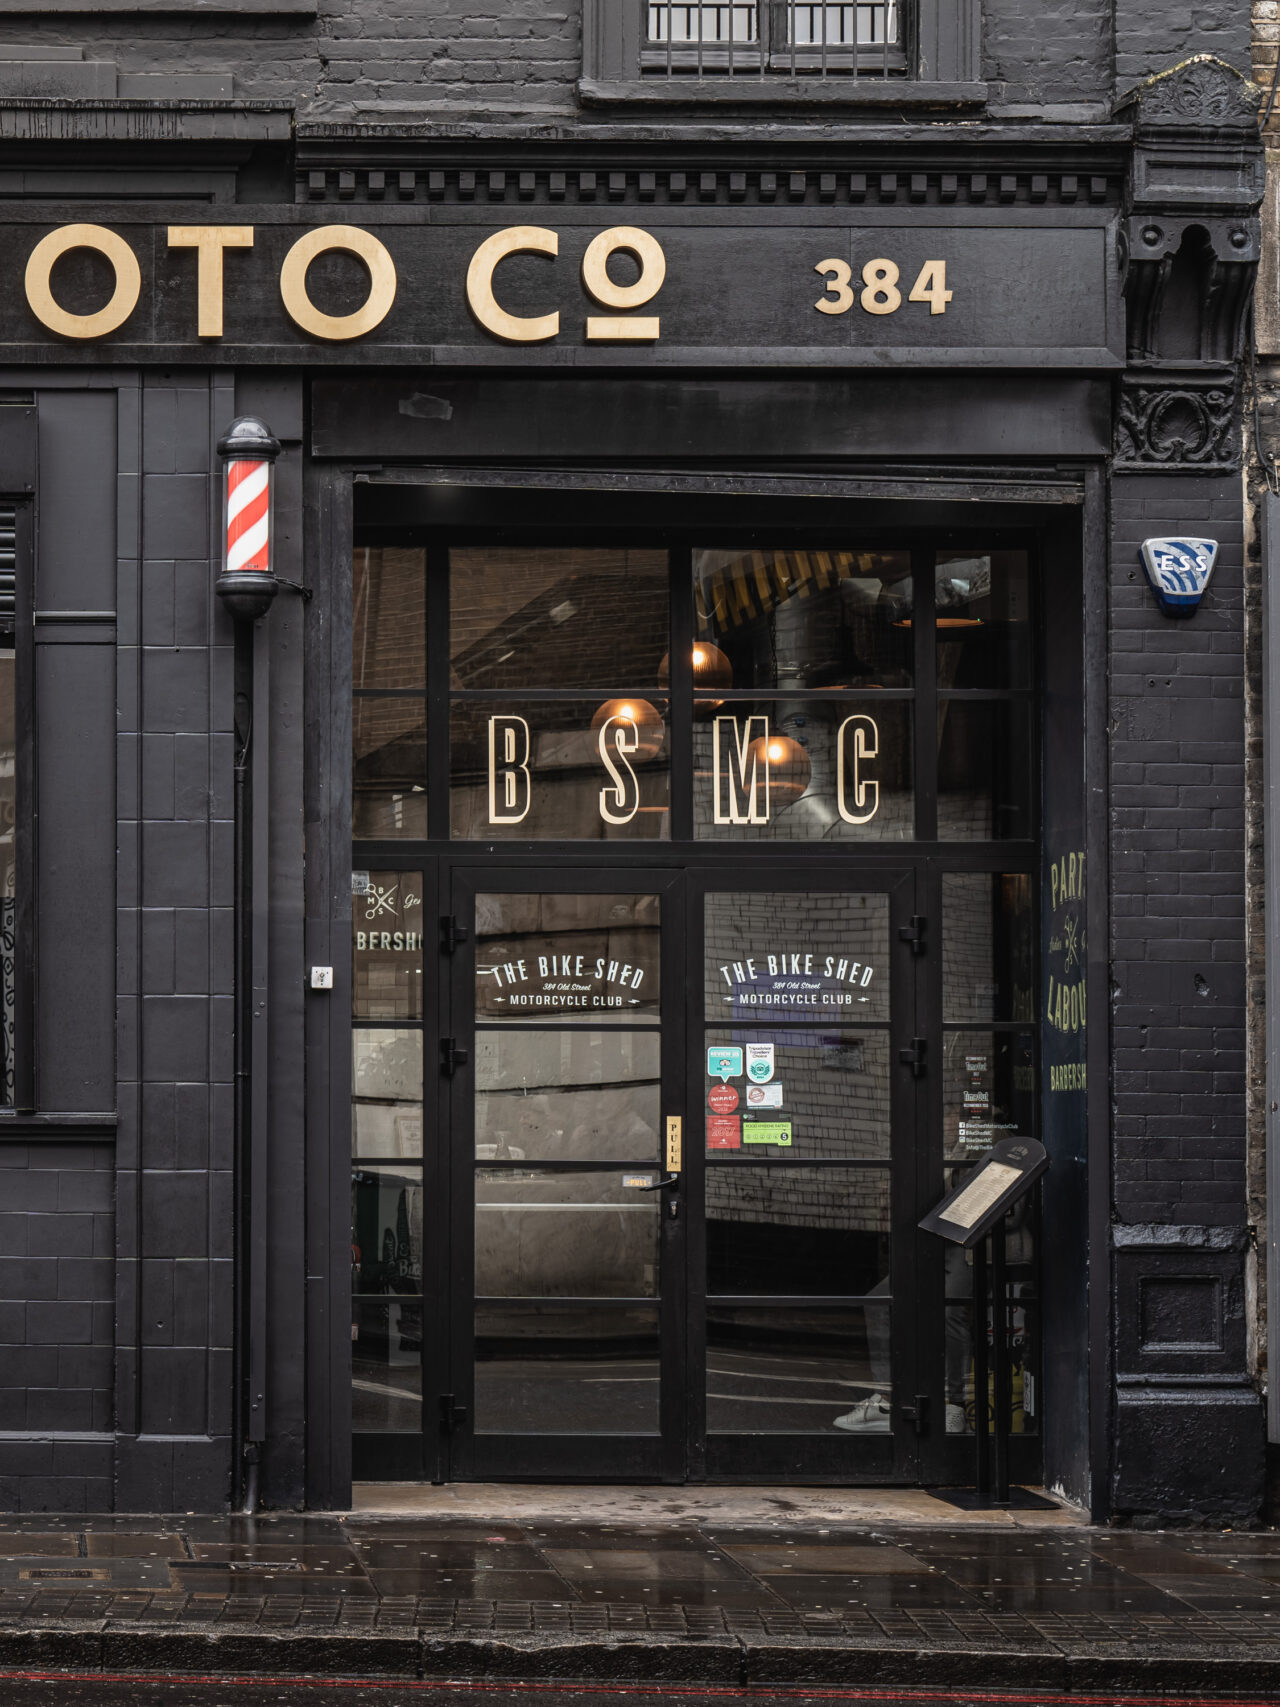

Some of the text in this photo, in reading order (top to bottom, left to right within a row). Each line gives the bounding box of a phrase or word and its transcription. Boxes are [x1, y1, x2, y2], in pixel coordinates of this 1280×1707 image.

[813, 257, 953, 316] 384
[1160, 554, 1208, 572] ESS
[490, 955, 644, 989] THE BIKE SHED
[720, 953, 874, 988] THE BIKE SHED
[509, 995, 623, 1006] MOTORCYCLE CLUB
[739, 994, 853, 1005] MOTORCYCLE CLUB
[670, 1124, 678, 1163] PULL
